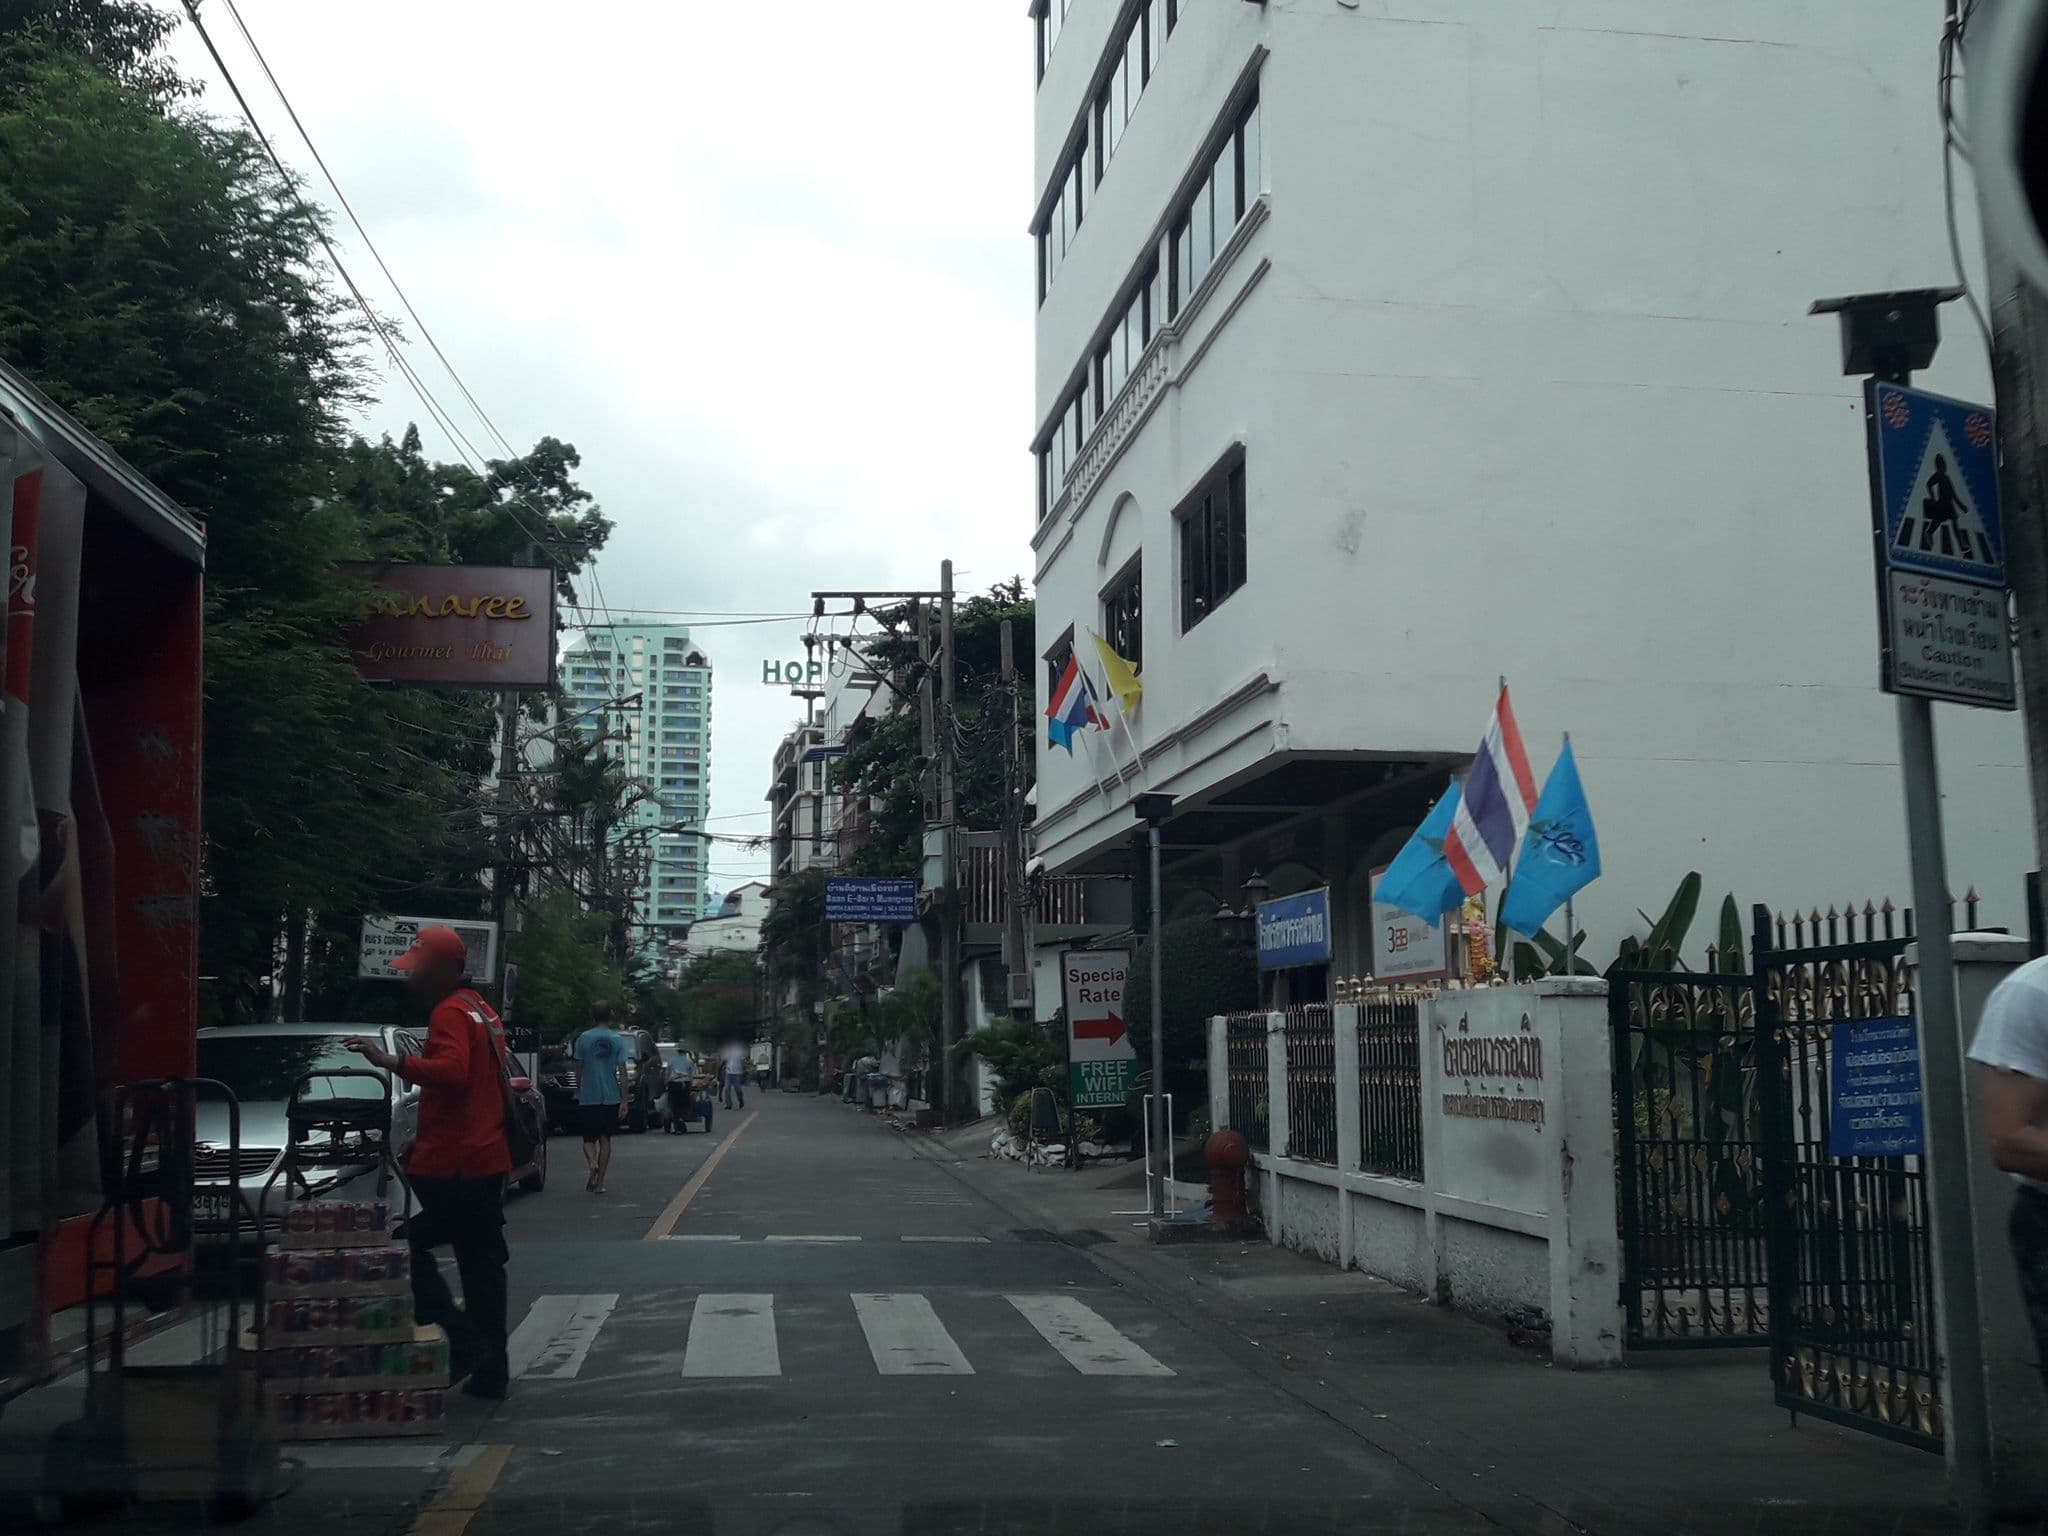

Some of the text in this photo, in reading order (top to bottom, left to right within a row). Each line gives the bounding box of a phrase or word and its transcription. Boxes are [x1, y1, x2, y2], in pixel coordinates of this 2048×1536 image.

[354, 640, 514, 663] Gourmet Thai
[1921, 645, 1985, 669] Caution
[763, 660, 834, 684] HOP
[1069, 967, 1129, 986] Special
[1079, 988, 1121, 1004] Rate
[1080, 1060, 1129, 1077] FREE
[1084, 1076, 1123, 1092] WIFI
[1076, 1090, 1129, 1104] INTERNE
